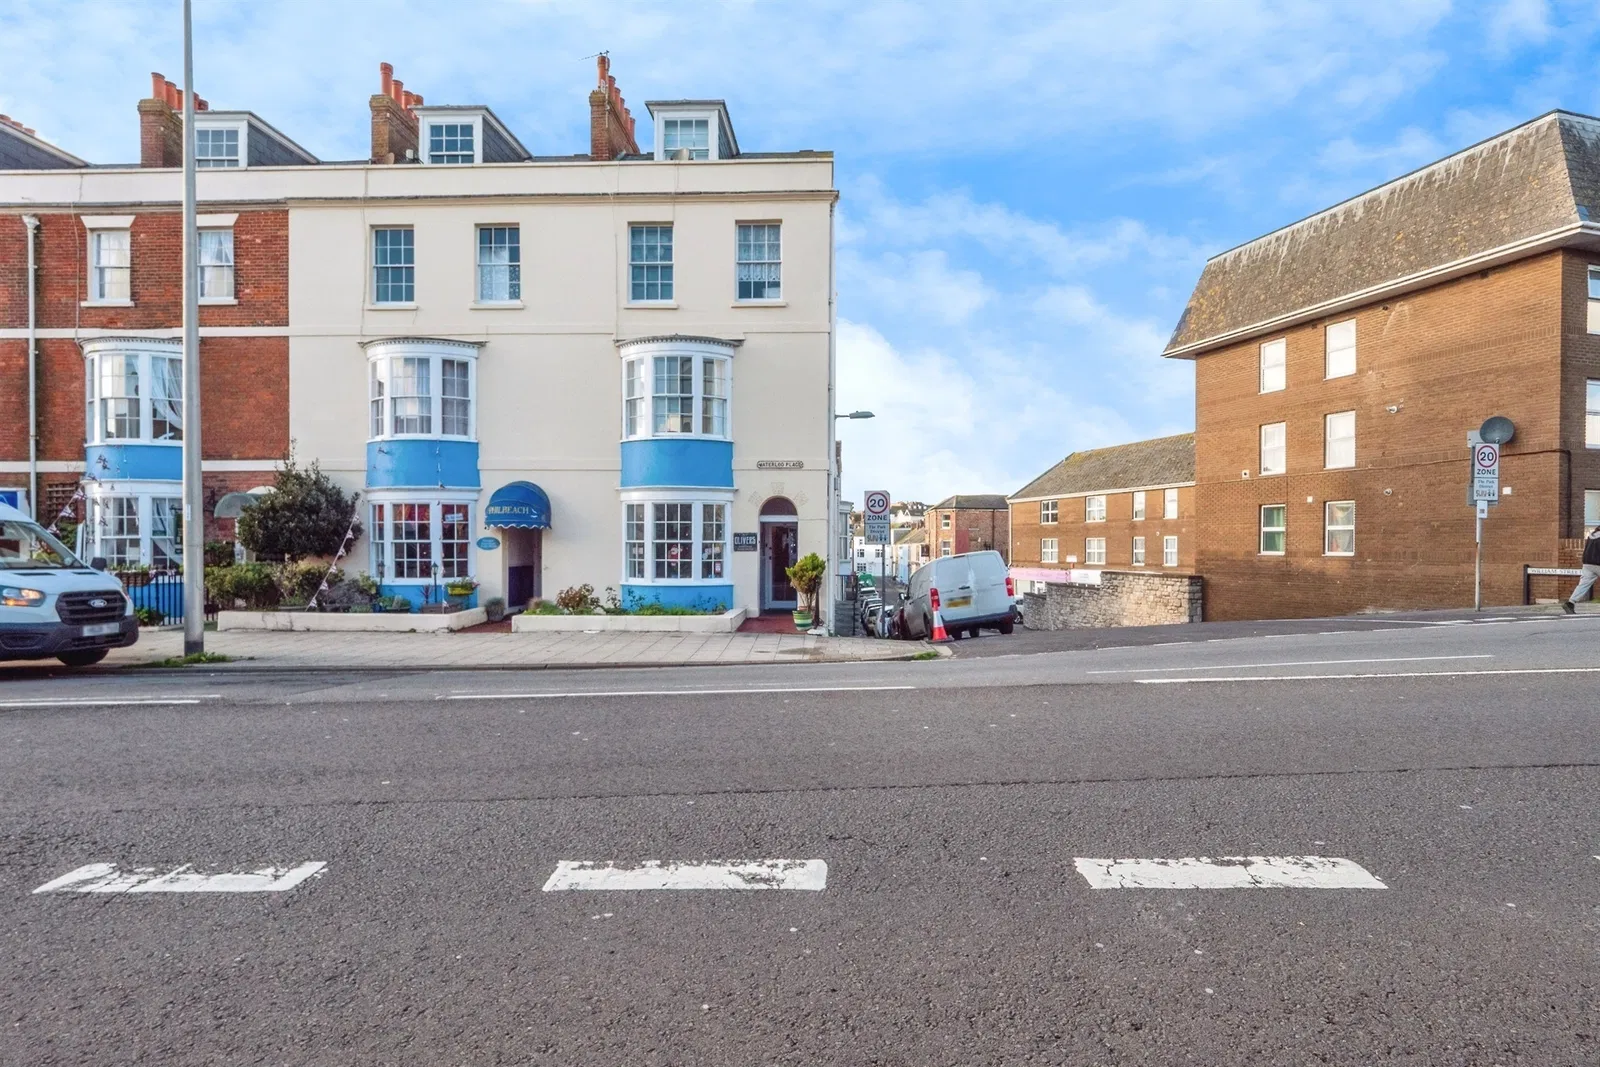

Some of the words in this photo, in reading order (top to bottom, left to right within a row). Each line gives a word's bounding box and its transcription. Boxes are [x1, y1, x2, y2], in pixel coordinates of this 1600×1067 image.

[1480, 452, 1494, 461] 20
[870, 498, 885, 508] 20
[488, 506, 529, 514] PHILBEACH
[735, 536, 756, 545] OLIVERS
